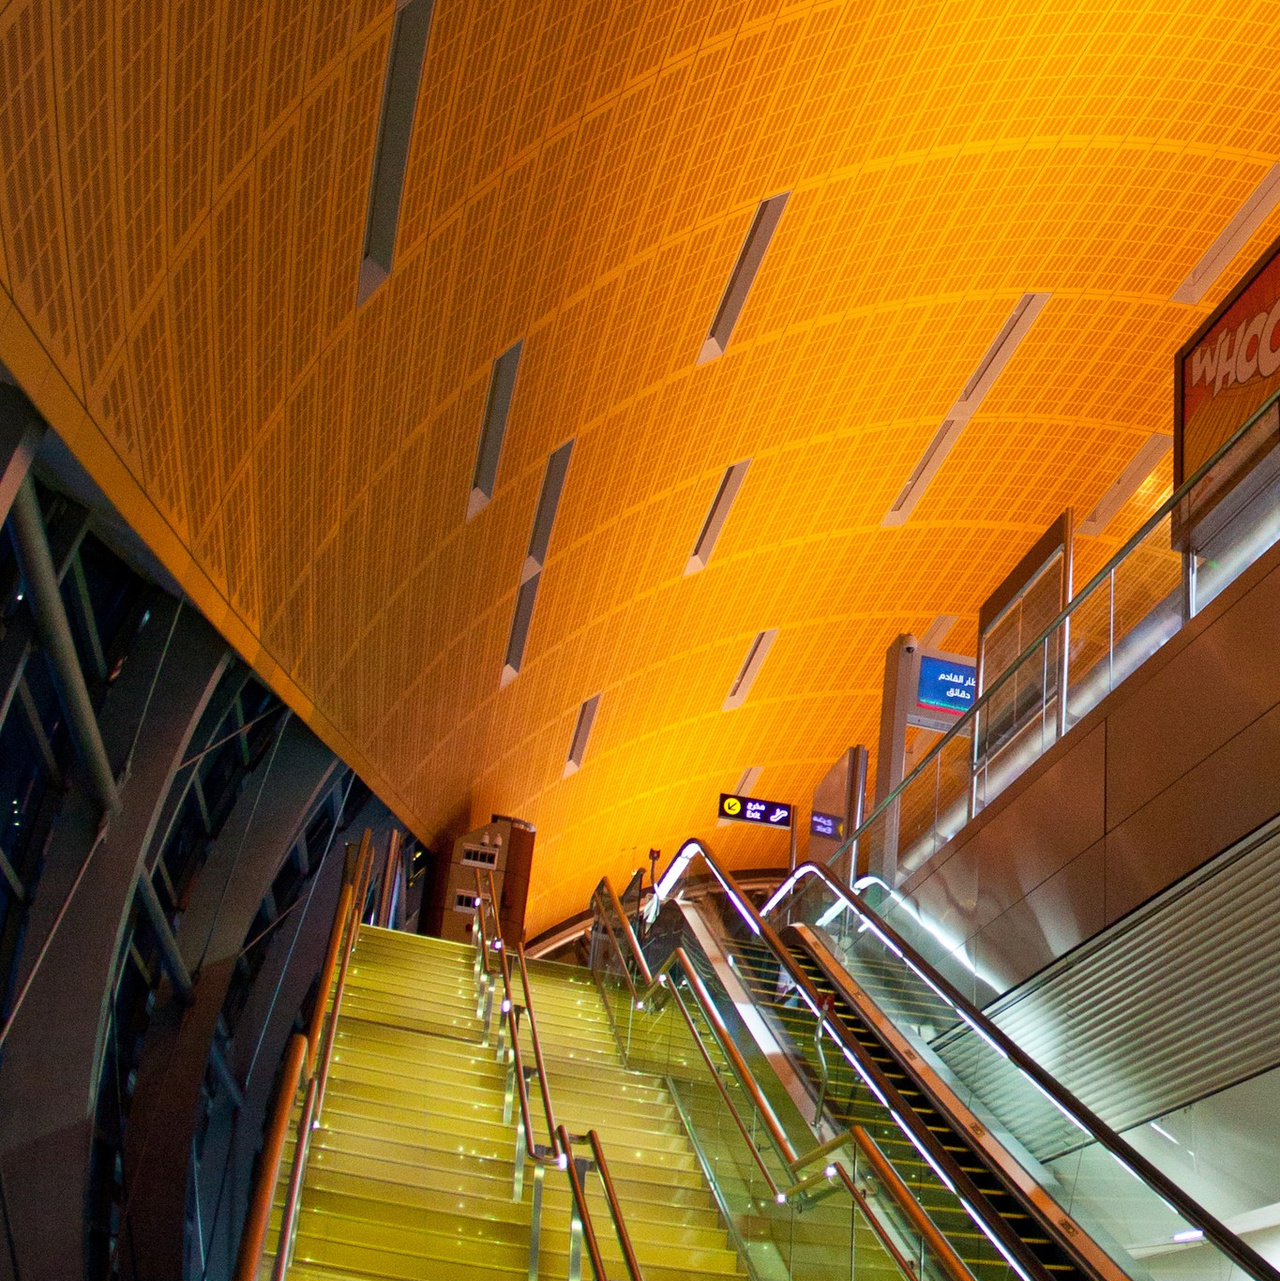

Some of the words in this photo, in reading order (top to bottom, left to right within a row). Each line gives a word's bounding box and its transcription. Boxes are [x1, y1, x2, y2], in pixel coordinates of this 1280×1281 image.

[938, 673, 963, 683] القادم
[946, 688, 970, 698] دقائق
[746, 810, 760, 819] Exit
